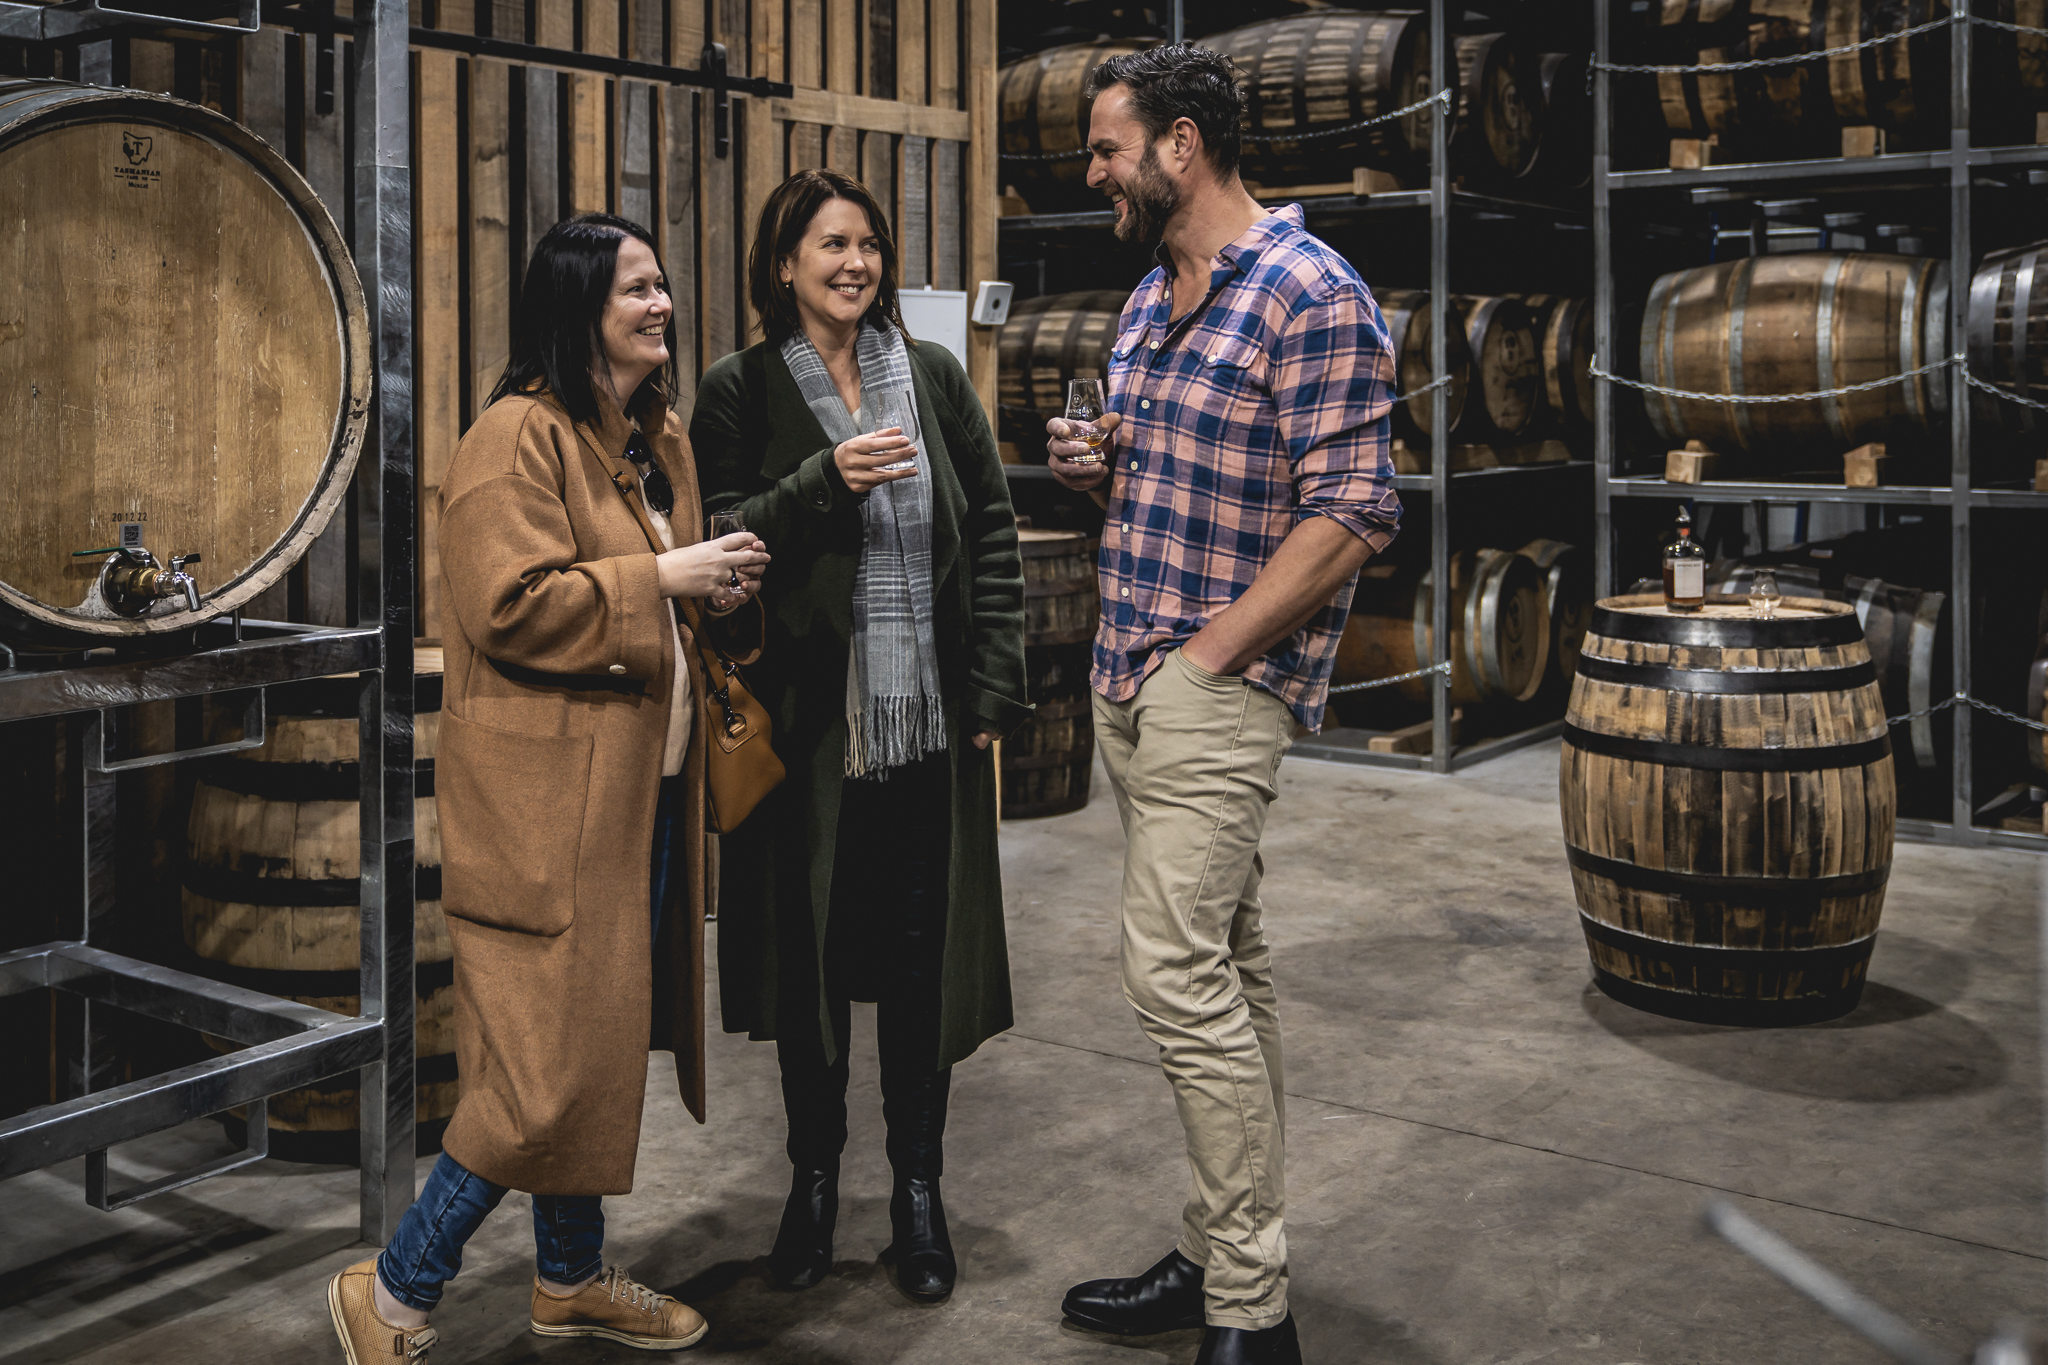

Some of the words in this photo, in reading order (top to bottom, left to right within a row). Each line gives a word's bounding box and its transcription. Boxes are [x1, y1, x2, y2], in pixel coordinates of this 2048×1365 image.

[133, 142, 143, 155] T
[114, 167, 160, 176] TASMANIAN
[112, 512, 122, 522] 20
[125, 512, 134, 522] 12
[137, 512, 147, 521] 22
